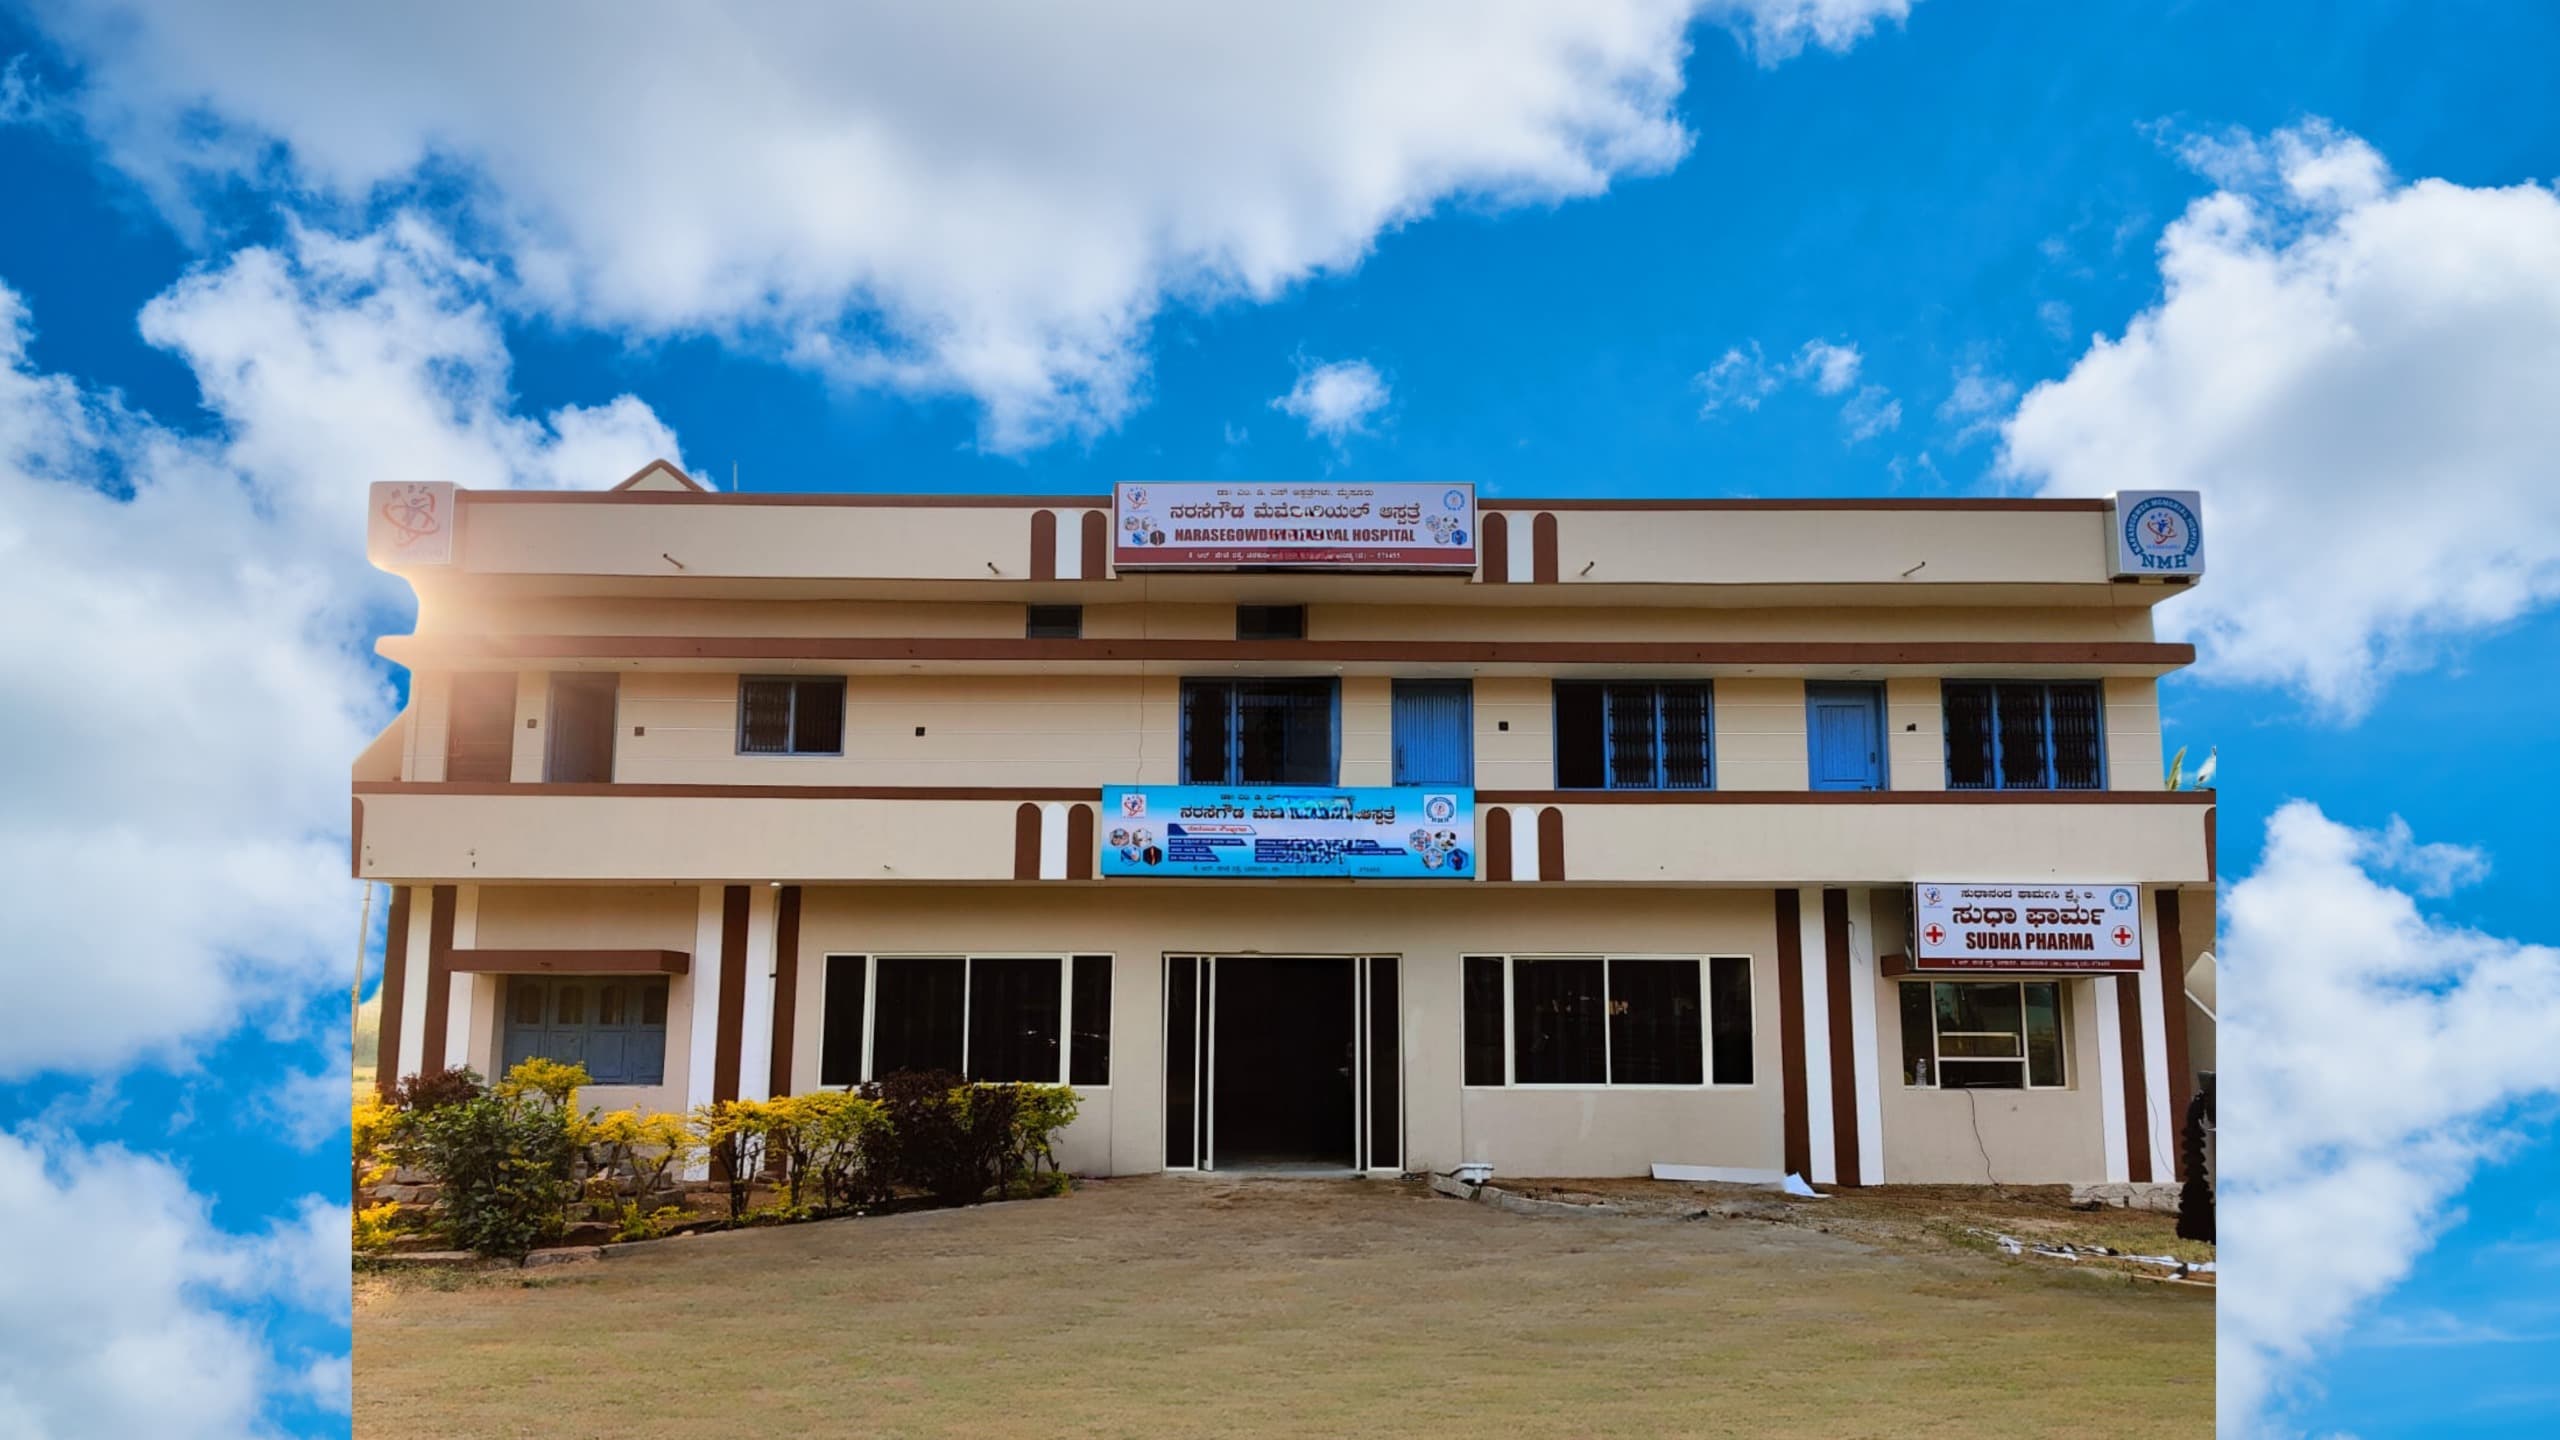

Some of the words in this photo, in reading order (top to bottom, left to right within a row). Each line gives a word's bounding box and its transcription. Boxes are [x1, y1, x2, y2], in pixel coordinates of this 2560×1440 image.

[1352, 529, 1416, 542] HOSPITAL
[2141, 553, 2188, 569] NMH
[1952, 903, 2017, 927] ಸುಧಾ
[1966, 932, 2022, 950] SUDHA
[2025, 933, 2094, 950] PHARMA
